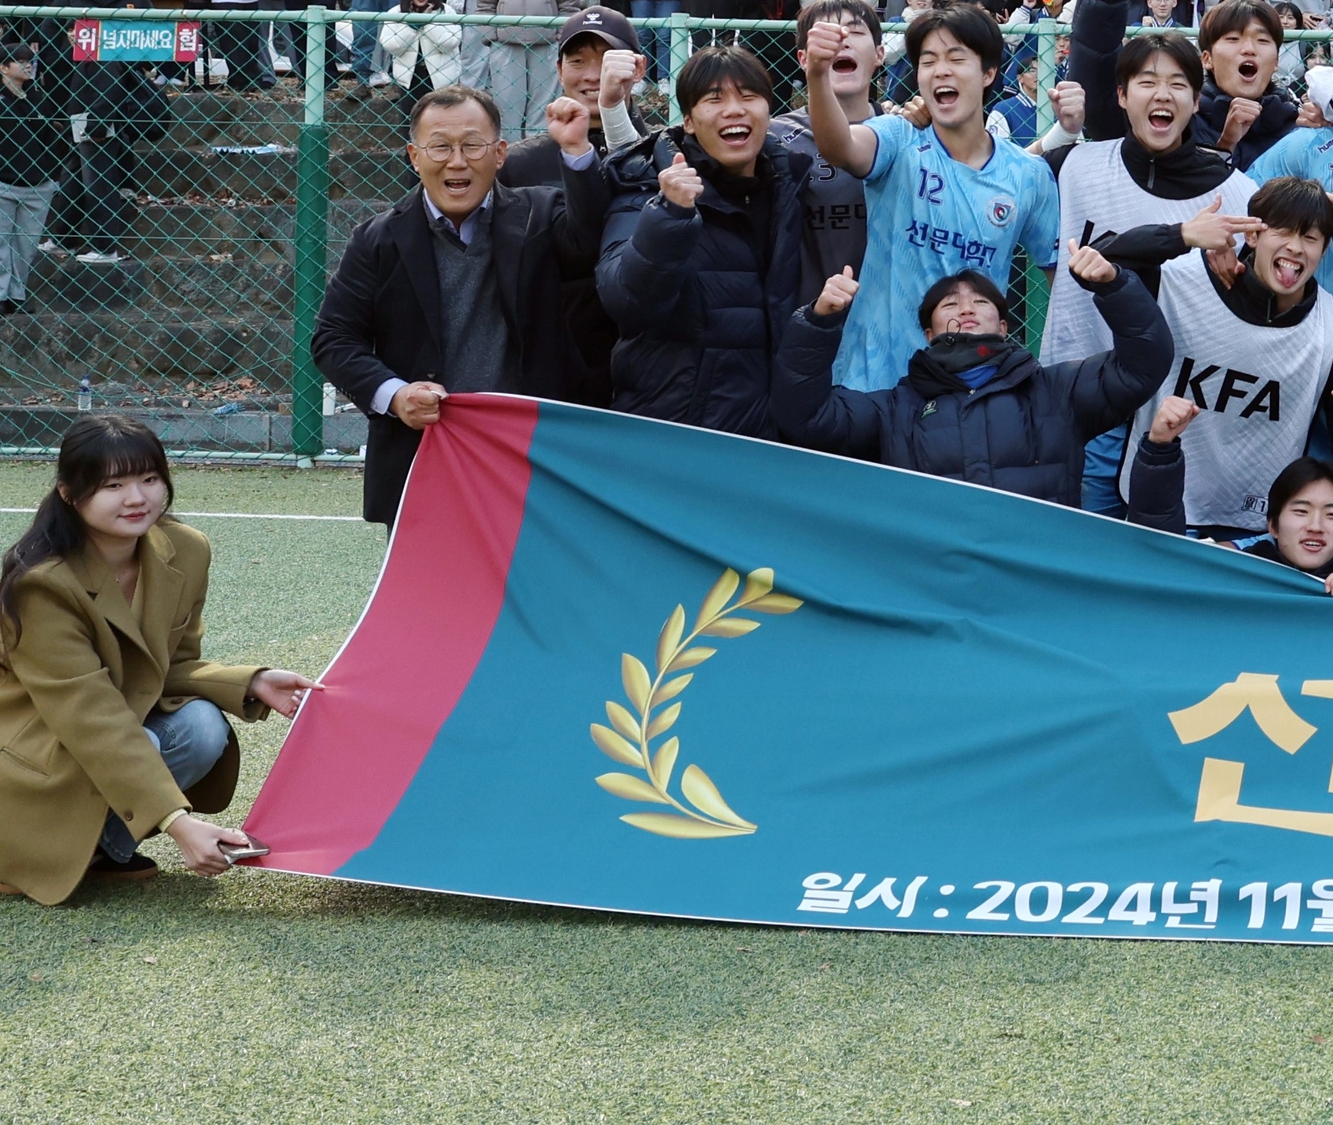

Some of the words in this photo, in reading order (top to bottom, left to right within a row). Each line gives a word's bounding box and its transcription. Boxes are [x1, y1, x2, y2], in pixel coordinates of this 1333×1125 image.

[78, 28, 96, 52] 위
[179, 28, 197, 52] 험
[917, 166, 947, 206] 12
[1172, 356, 1280, 422] KFA
[796, 872, 929, 917] 일시
[970, 880, 1221, 931] 2024년
